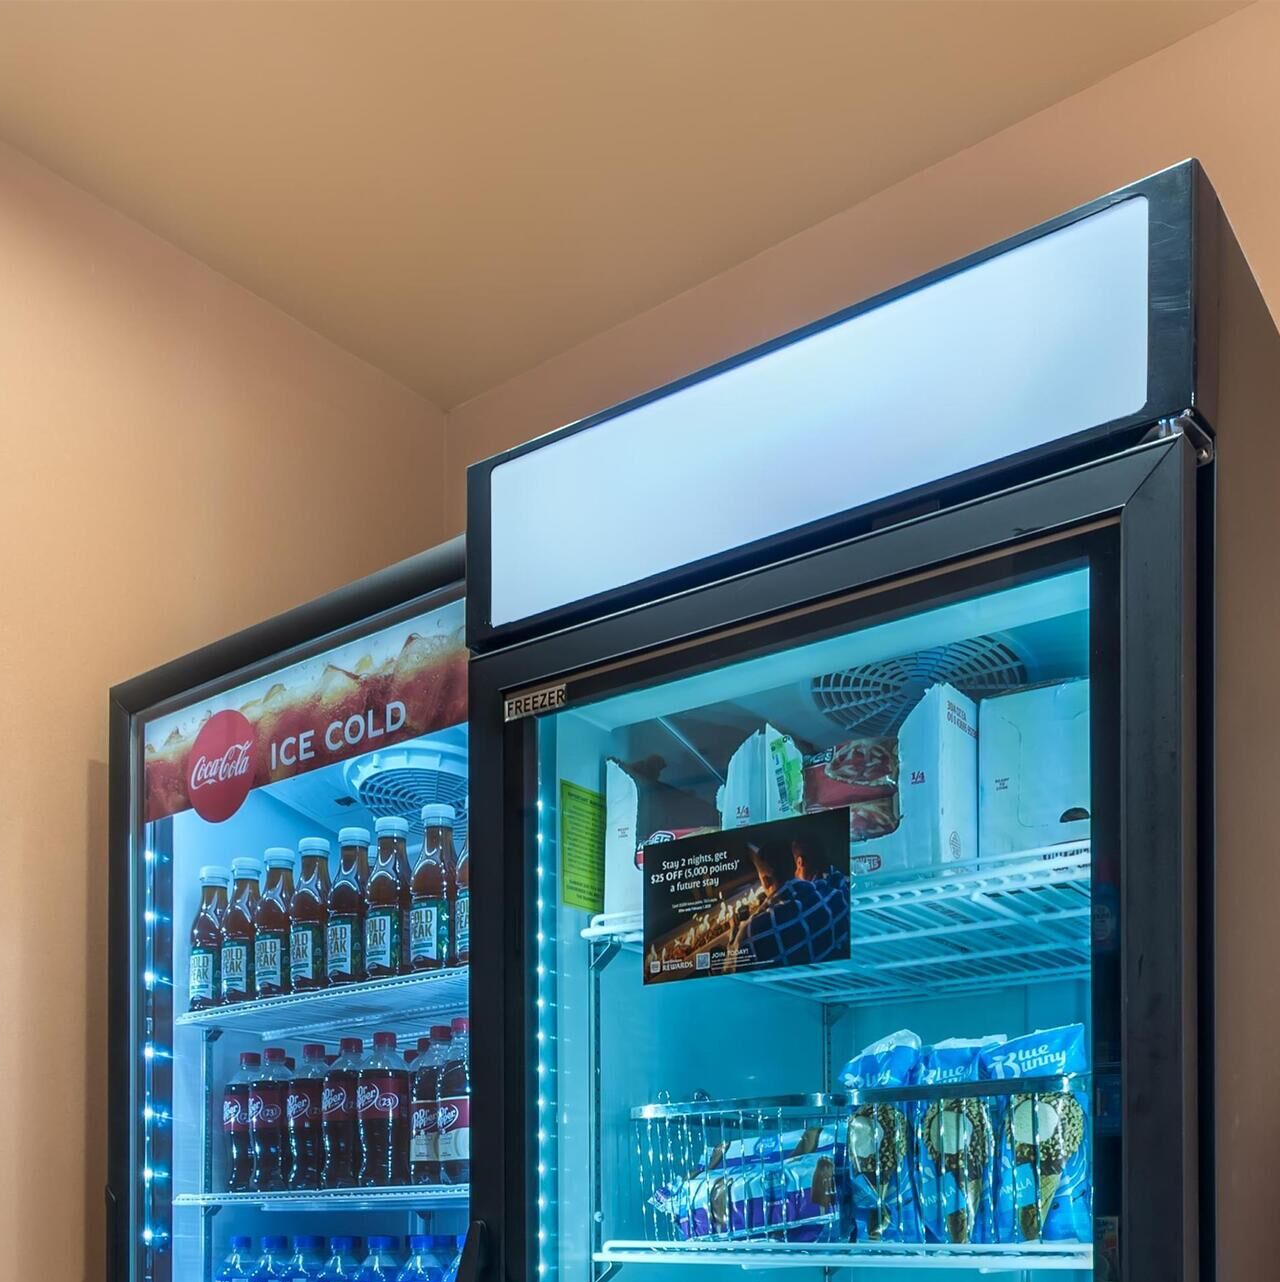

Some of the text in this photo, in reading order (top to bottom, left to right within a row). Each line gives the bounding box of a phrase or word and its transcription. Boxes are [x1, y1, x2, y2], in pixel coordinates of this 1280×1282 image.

[508, 689, 566, 717] FREEZER
[270, 701, 407, 769] ICE COLD
[190, 741, 252, 790] Coca-Cola
[662, 851, 727, 870] Stay 2 nights, get
[650, 873, 664, 884] $25
[666, 870, 684, 881] OFF
[684, 866, 708, 879] (5,000
[677, 880, 700, 891] future
[702, 877, 719, 887] stay
[711, 951, 726, 959] JOIN
